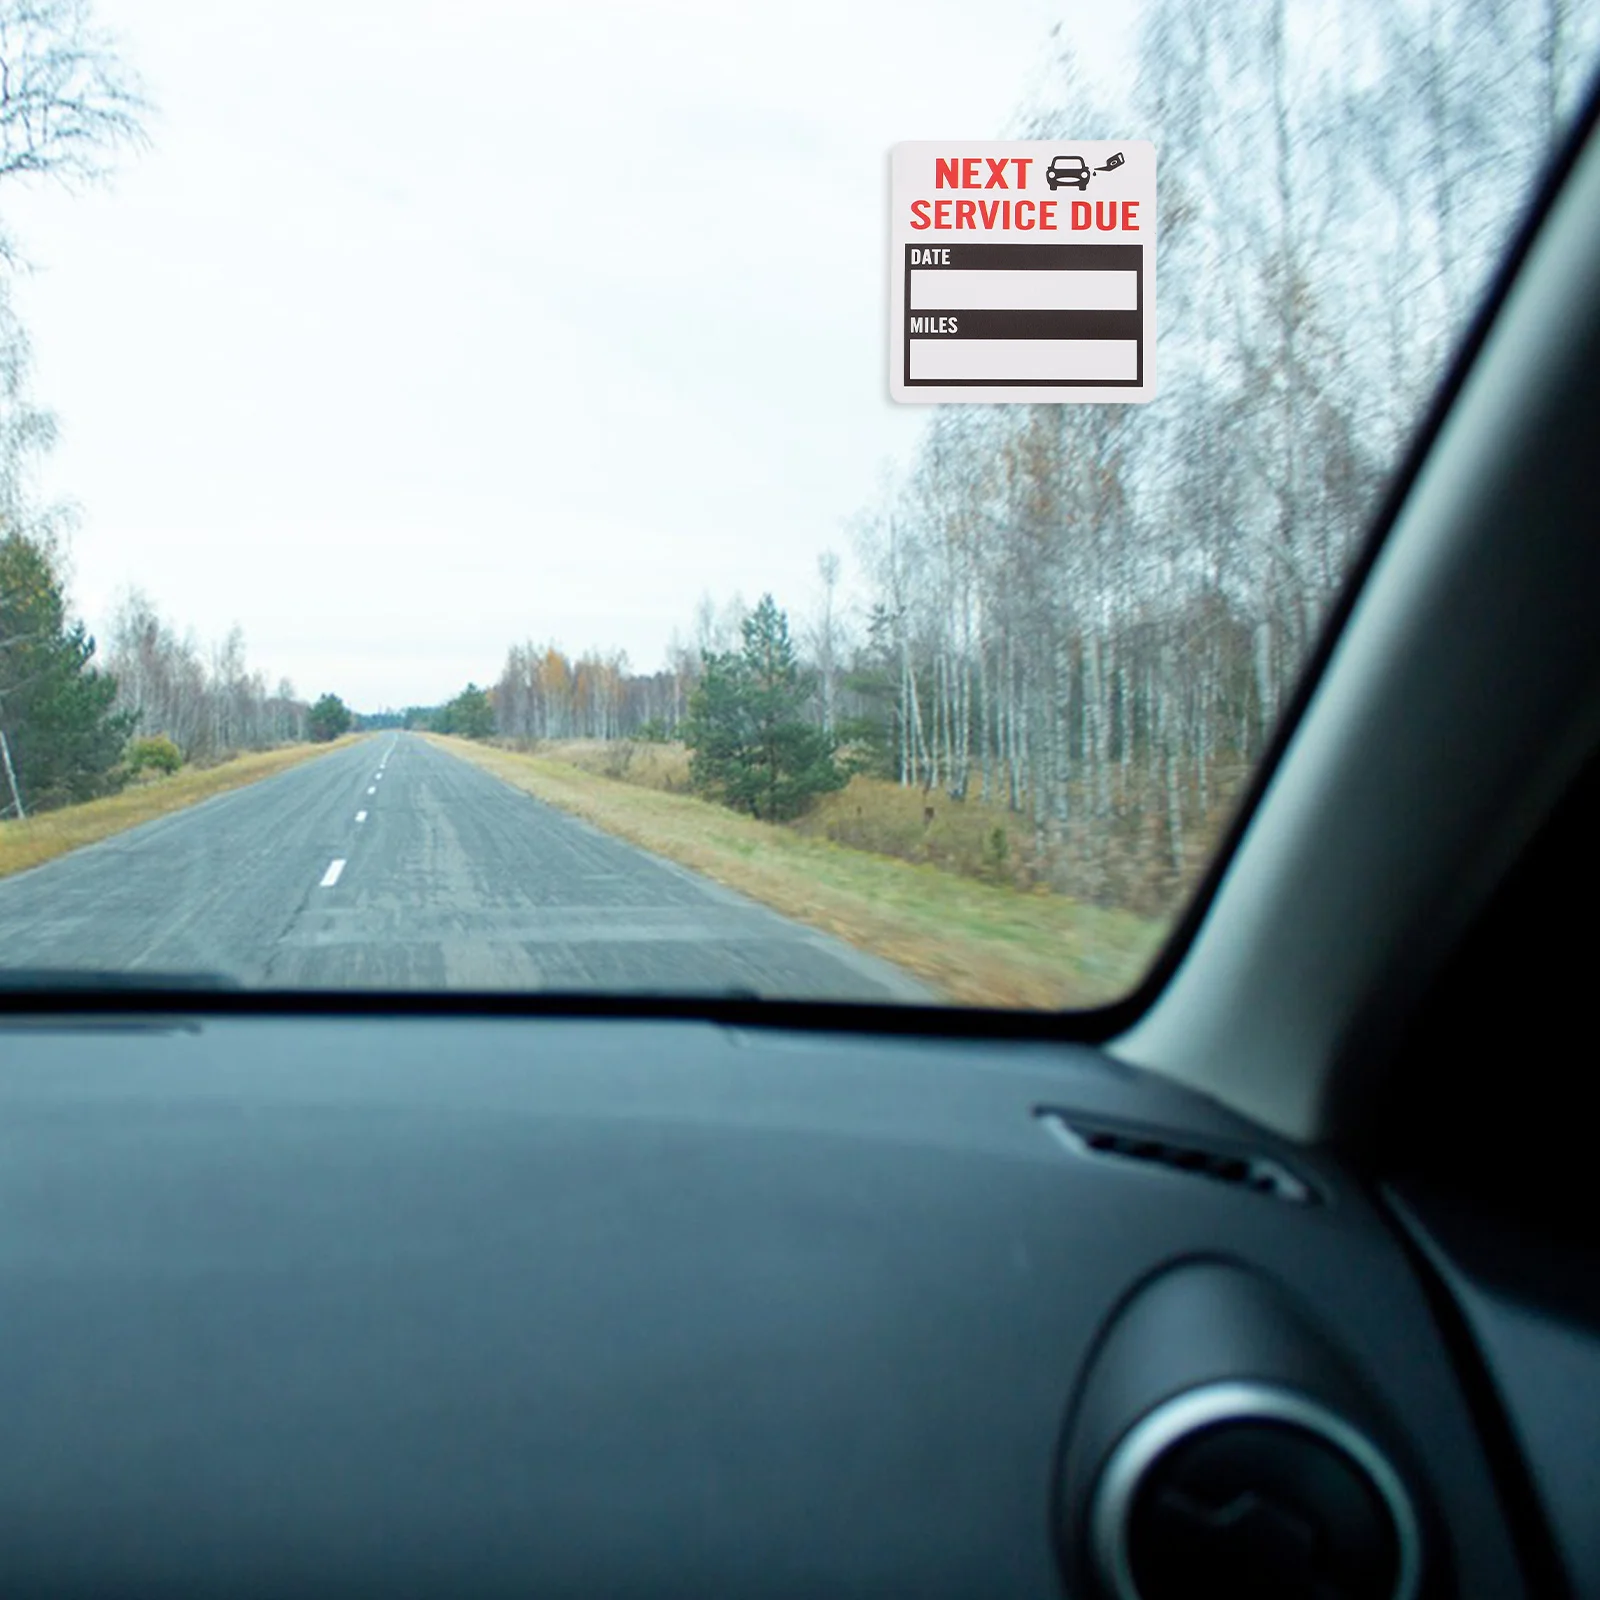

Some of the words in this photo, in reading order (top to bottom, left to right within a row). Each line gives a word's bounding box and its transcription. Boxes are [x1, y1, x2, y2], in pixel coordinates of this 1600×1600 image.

[935, 158, 1033, 189] NEXT
[910, 200, 1057, 231] SERVICE
[1071, 201, 1139, 231] DUE
[910, 249, 951, 265] DATE
[910, 316, 958, 334] MILES
